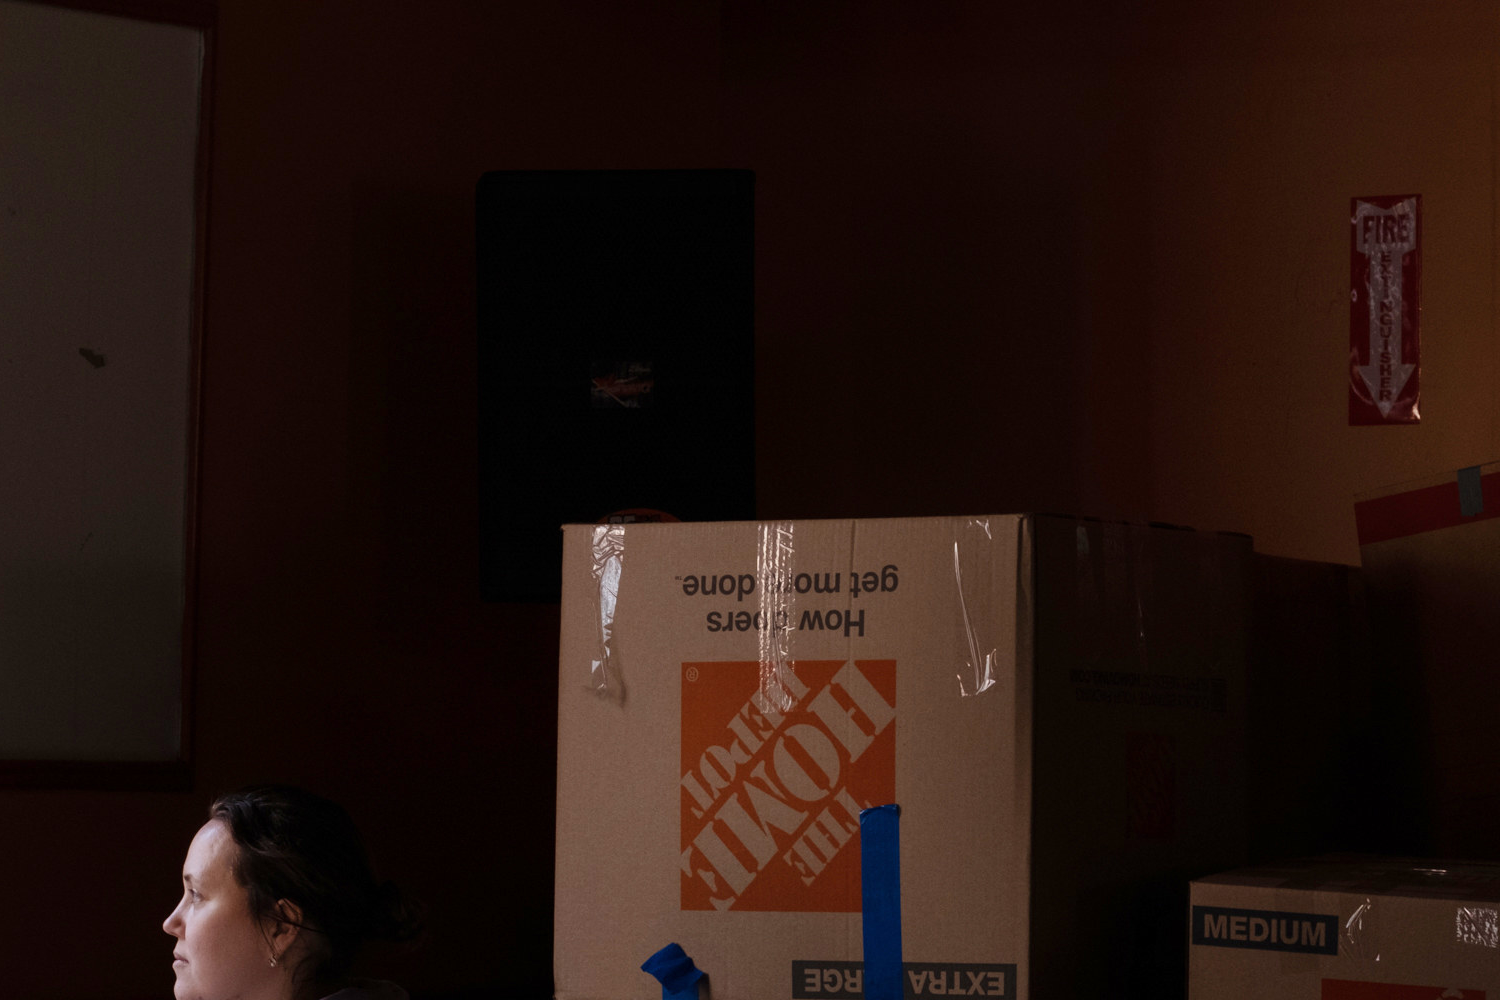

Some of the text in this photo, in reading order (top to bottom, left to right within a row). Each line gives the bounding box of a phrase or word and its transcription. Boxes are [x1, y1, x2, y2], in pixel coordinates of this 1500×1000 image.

[1363, 214, 1410, 244] FIRE
[849, 564, 899, 598] get
[800, 610, 865, 637] How
[681, 659, 897, 911] HOME
[784, 788, 872, 886] THE
[1203, 914, 1327, 948] MEDIUM
[804, 968, 1005, 996] EXTRA RGE
